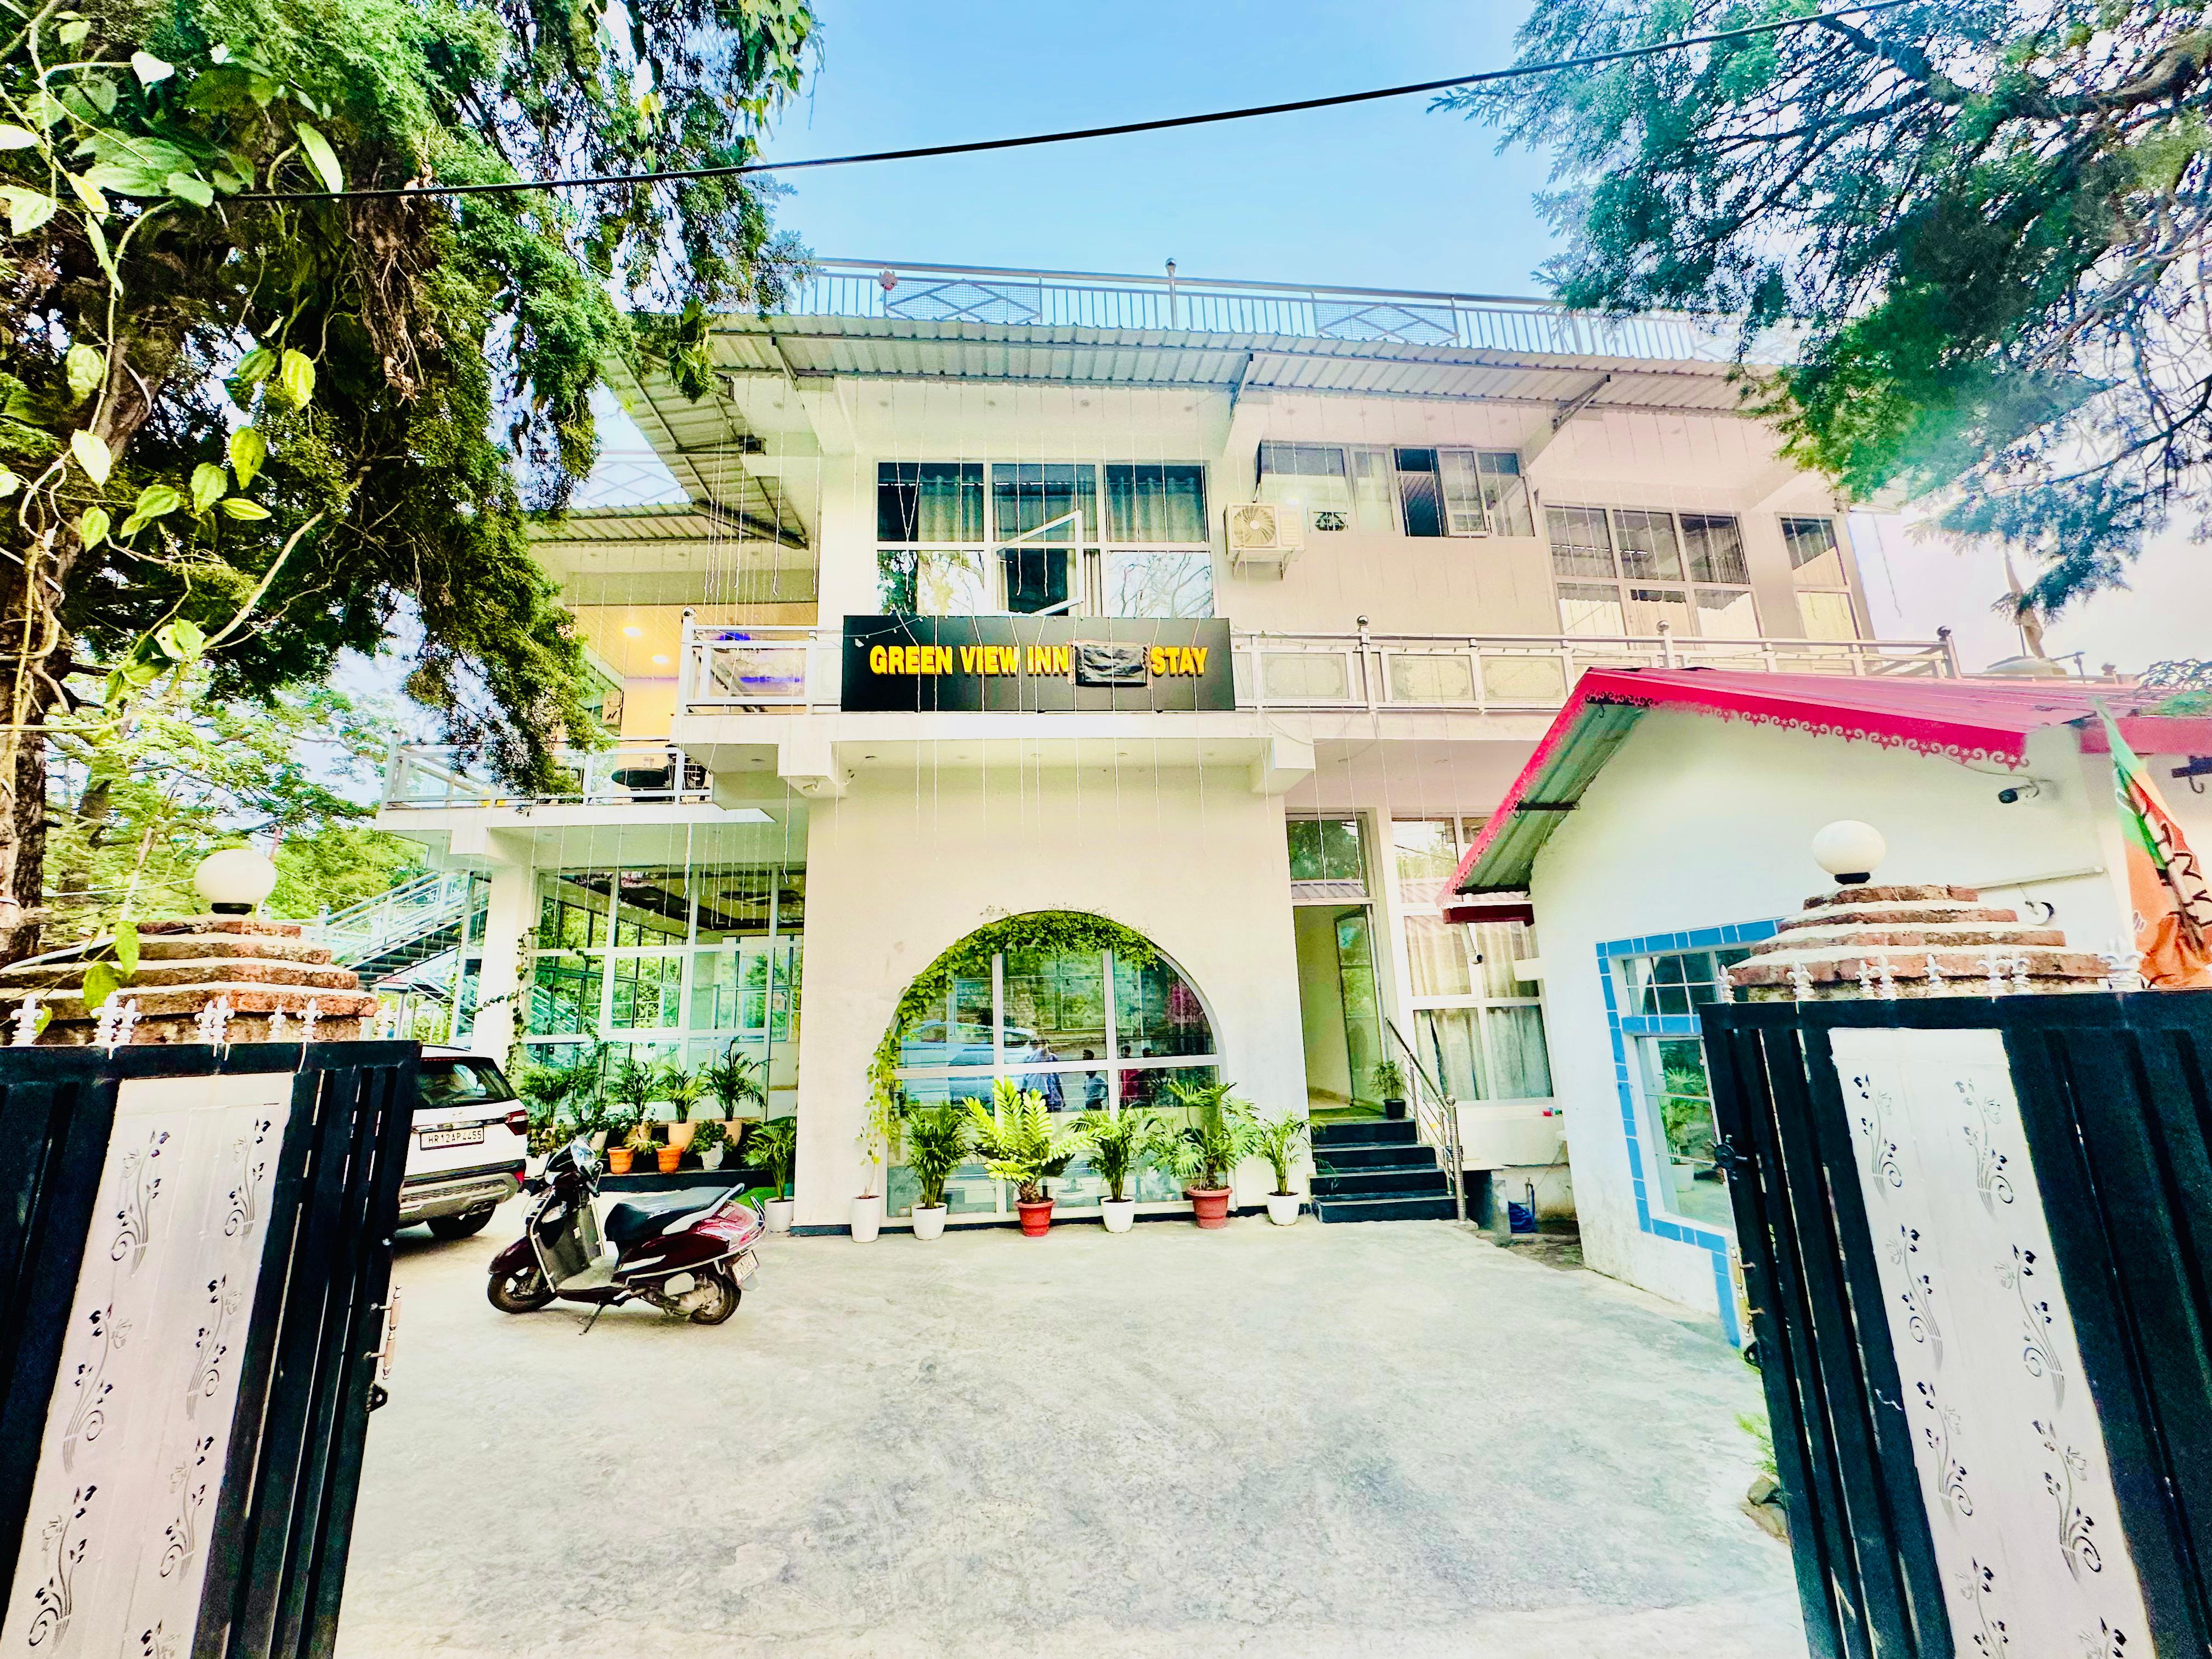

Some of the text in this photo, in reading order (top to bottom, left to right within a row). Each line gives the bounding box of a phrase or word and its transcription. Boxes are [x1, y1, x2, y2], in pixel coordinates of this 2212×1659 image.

[870, 645, 1208, 675] GREEN VIEW INN STAY
[428, 1130, 482, 1144] HR12AP4455
